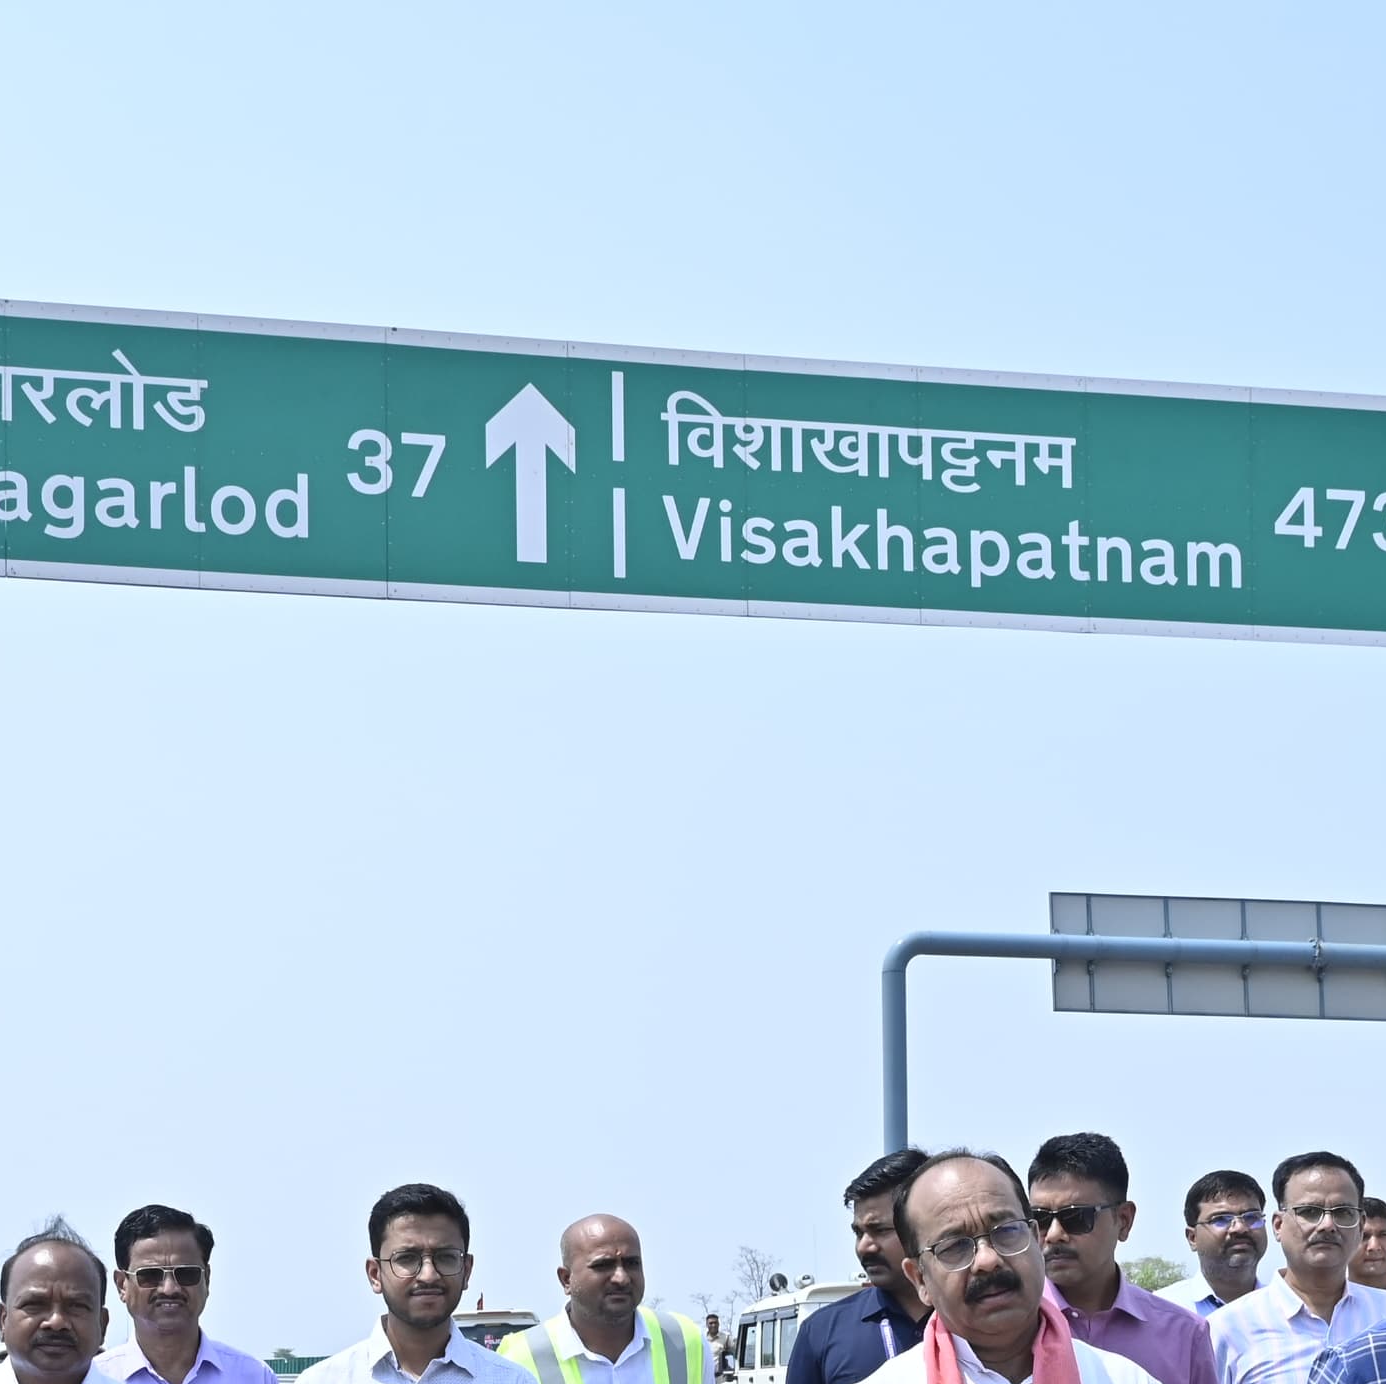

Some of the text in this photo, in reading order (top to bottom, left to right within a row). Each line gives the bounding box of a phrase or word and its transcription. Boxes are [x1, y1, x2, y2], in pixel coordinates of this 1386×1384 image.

[346, 428, 446, 498] 37
[660, 390, 1077, 494] विशाखापट्टनम
[661, 494, 1242, 589] Visakhapatnam
